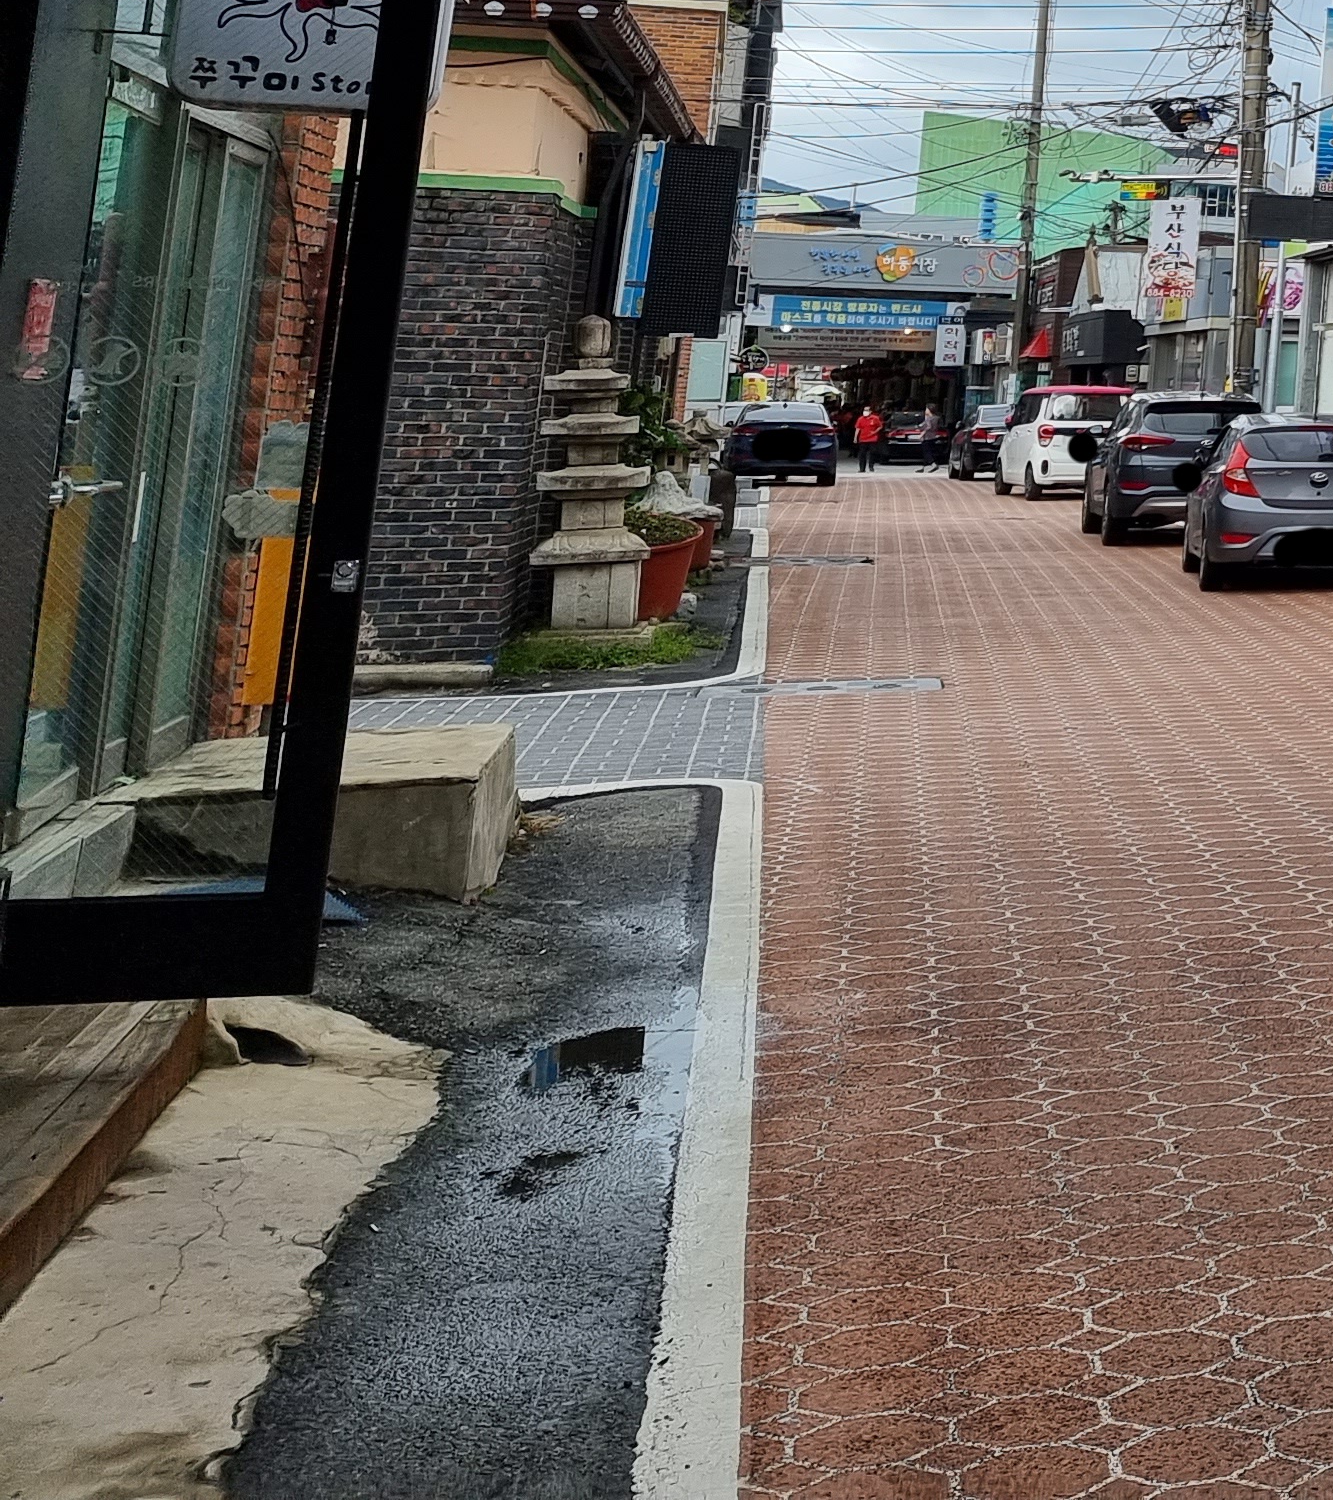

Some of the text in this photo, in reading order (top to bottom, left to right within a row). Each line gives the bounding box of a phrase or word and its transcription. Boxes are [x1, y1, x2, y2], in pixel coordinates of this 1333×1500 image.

[189, 55, 373, 95] 쭈꾸미 Sto
[1162, 203, 1188, 278] 부산식당
[882, 255, 938, 273] 하동시장
